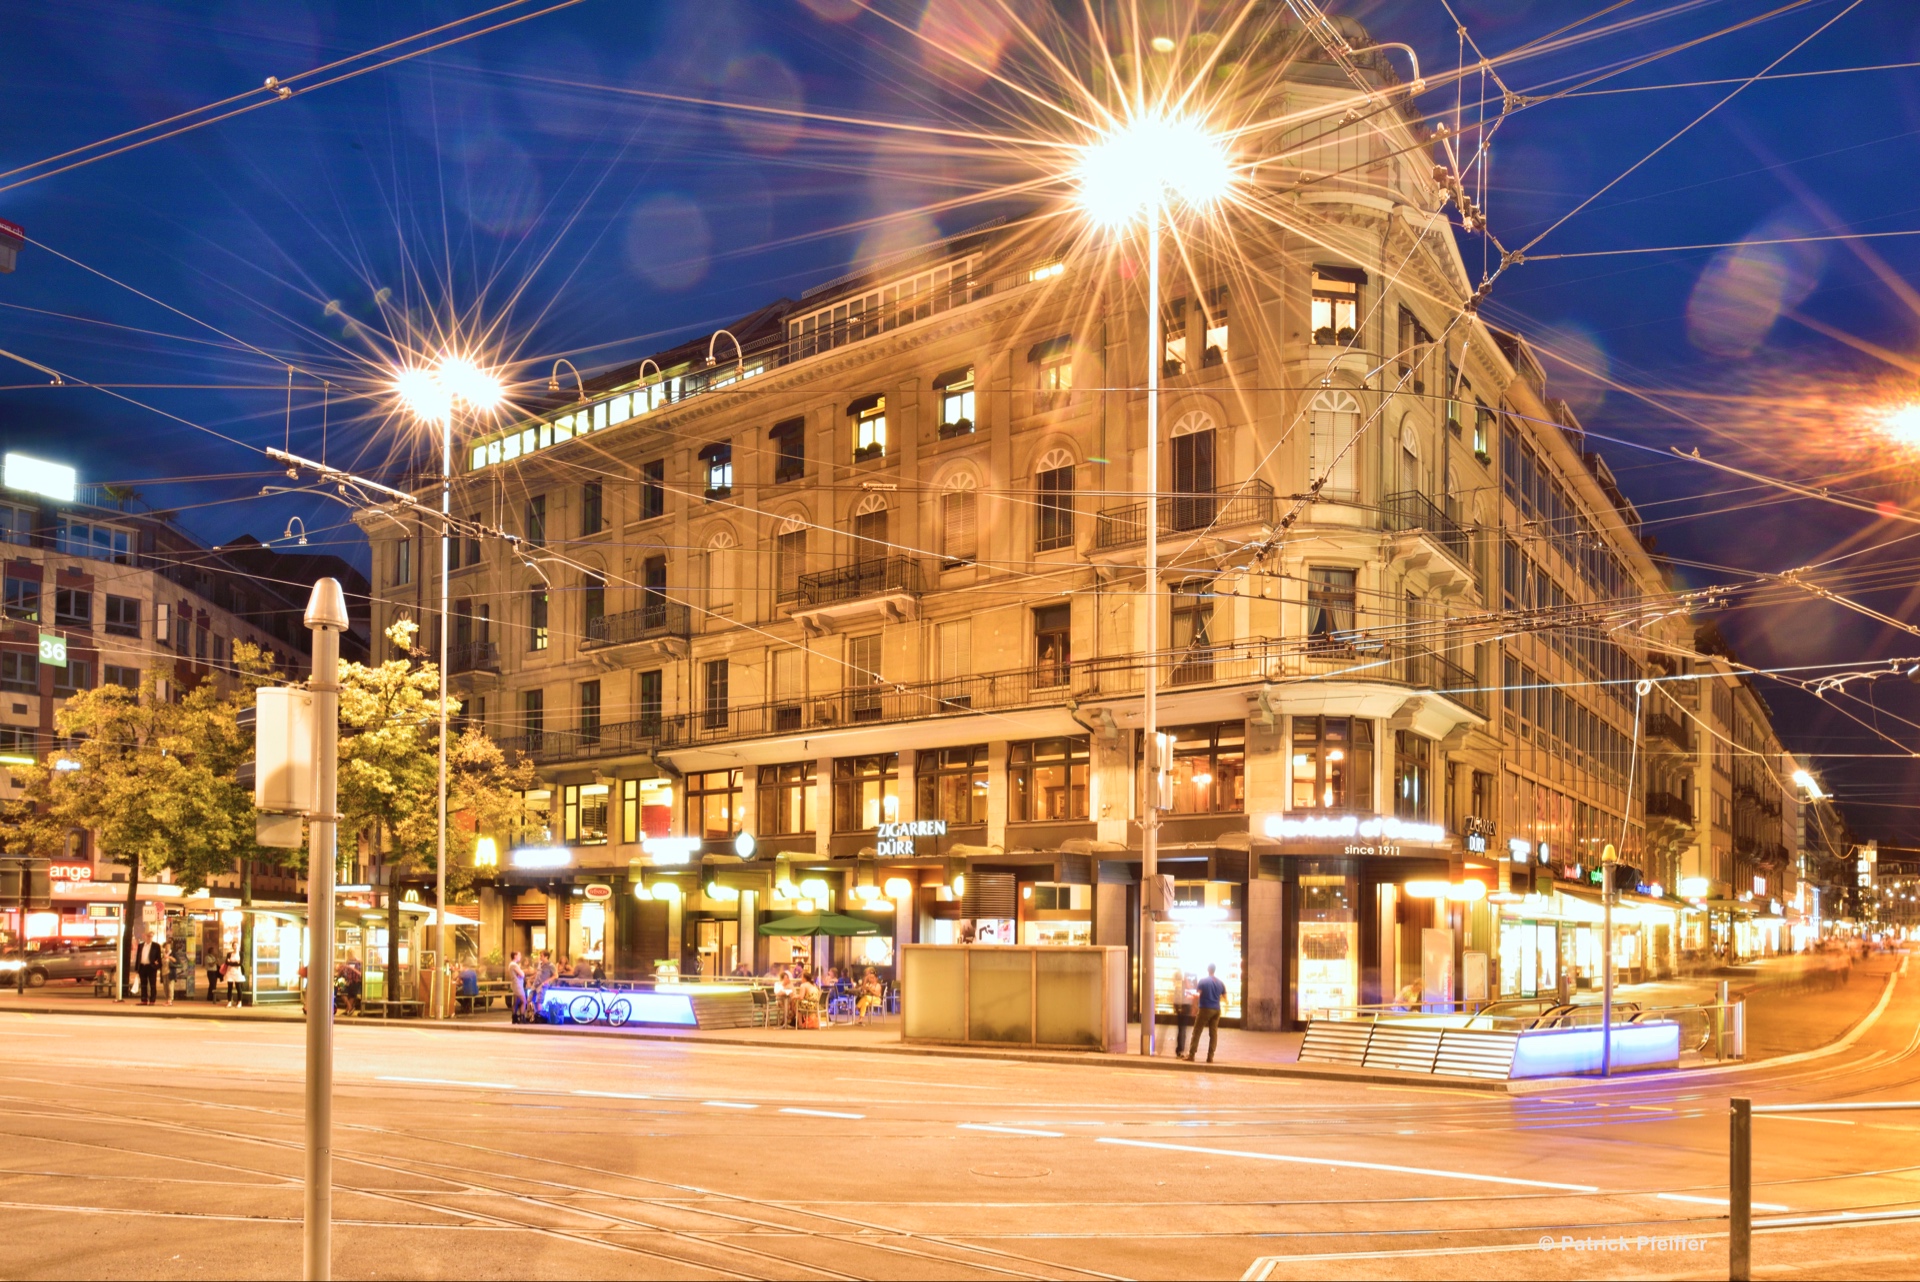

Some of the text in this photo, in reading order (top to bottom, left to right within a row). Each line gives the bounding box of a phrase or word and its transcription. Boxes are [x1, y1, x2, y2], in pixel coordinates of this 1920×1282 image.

[40, 641, 66, 661] 36
[877, 821, 946, 837] ZIGARREN
[877, 838, 914, 855] DÜRR
[1344, 844, 1400, 856] since 1911
[50, 866, 91, 880] ange
